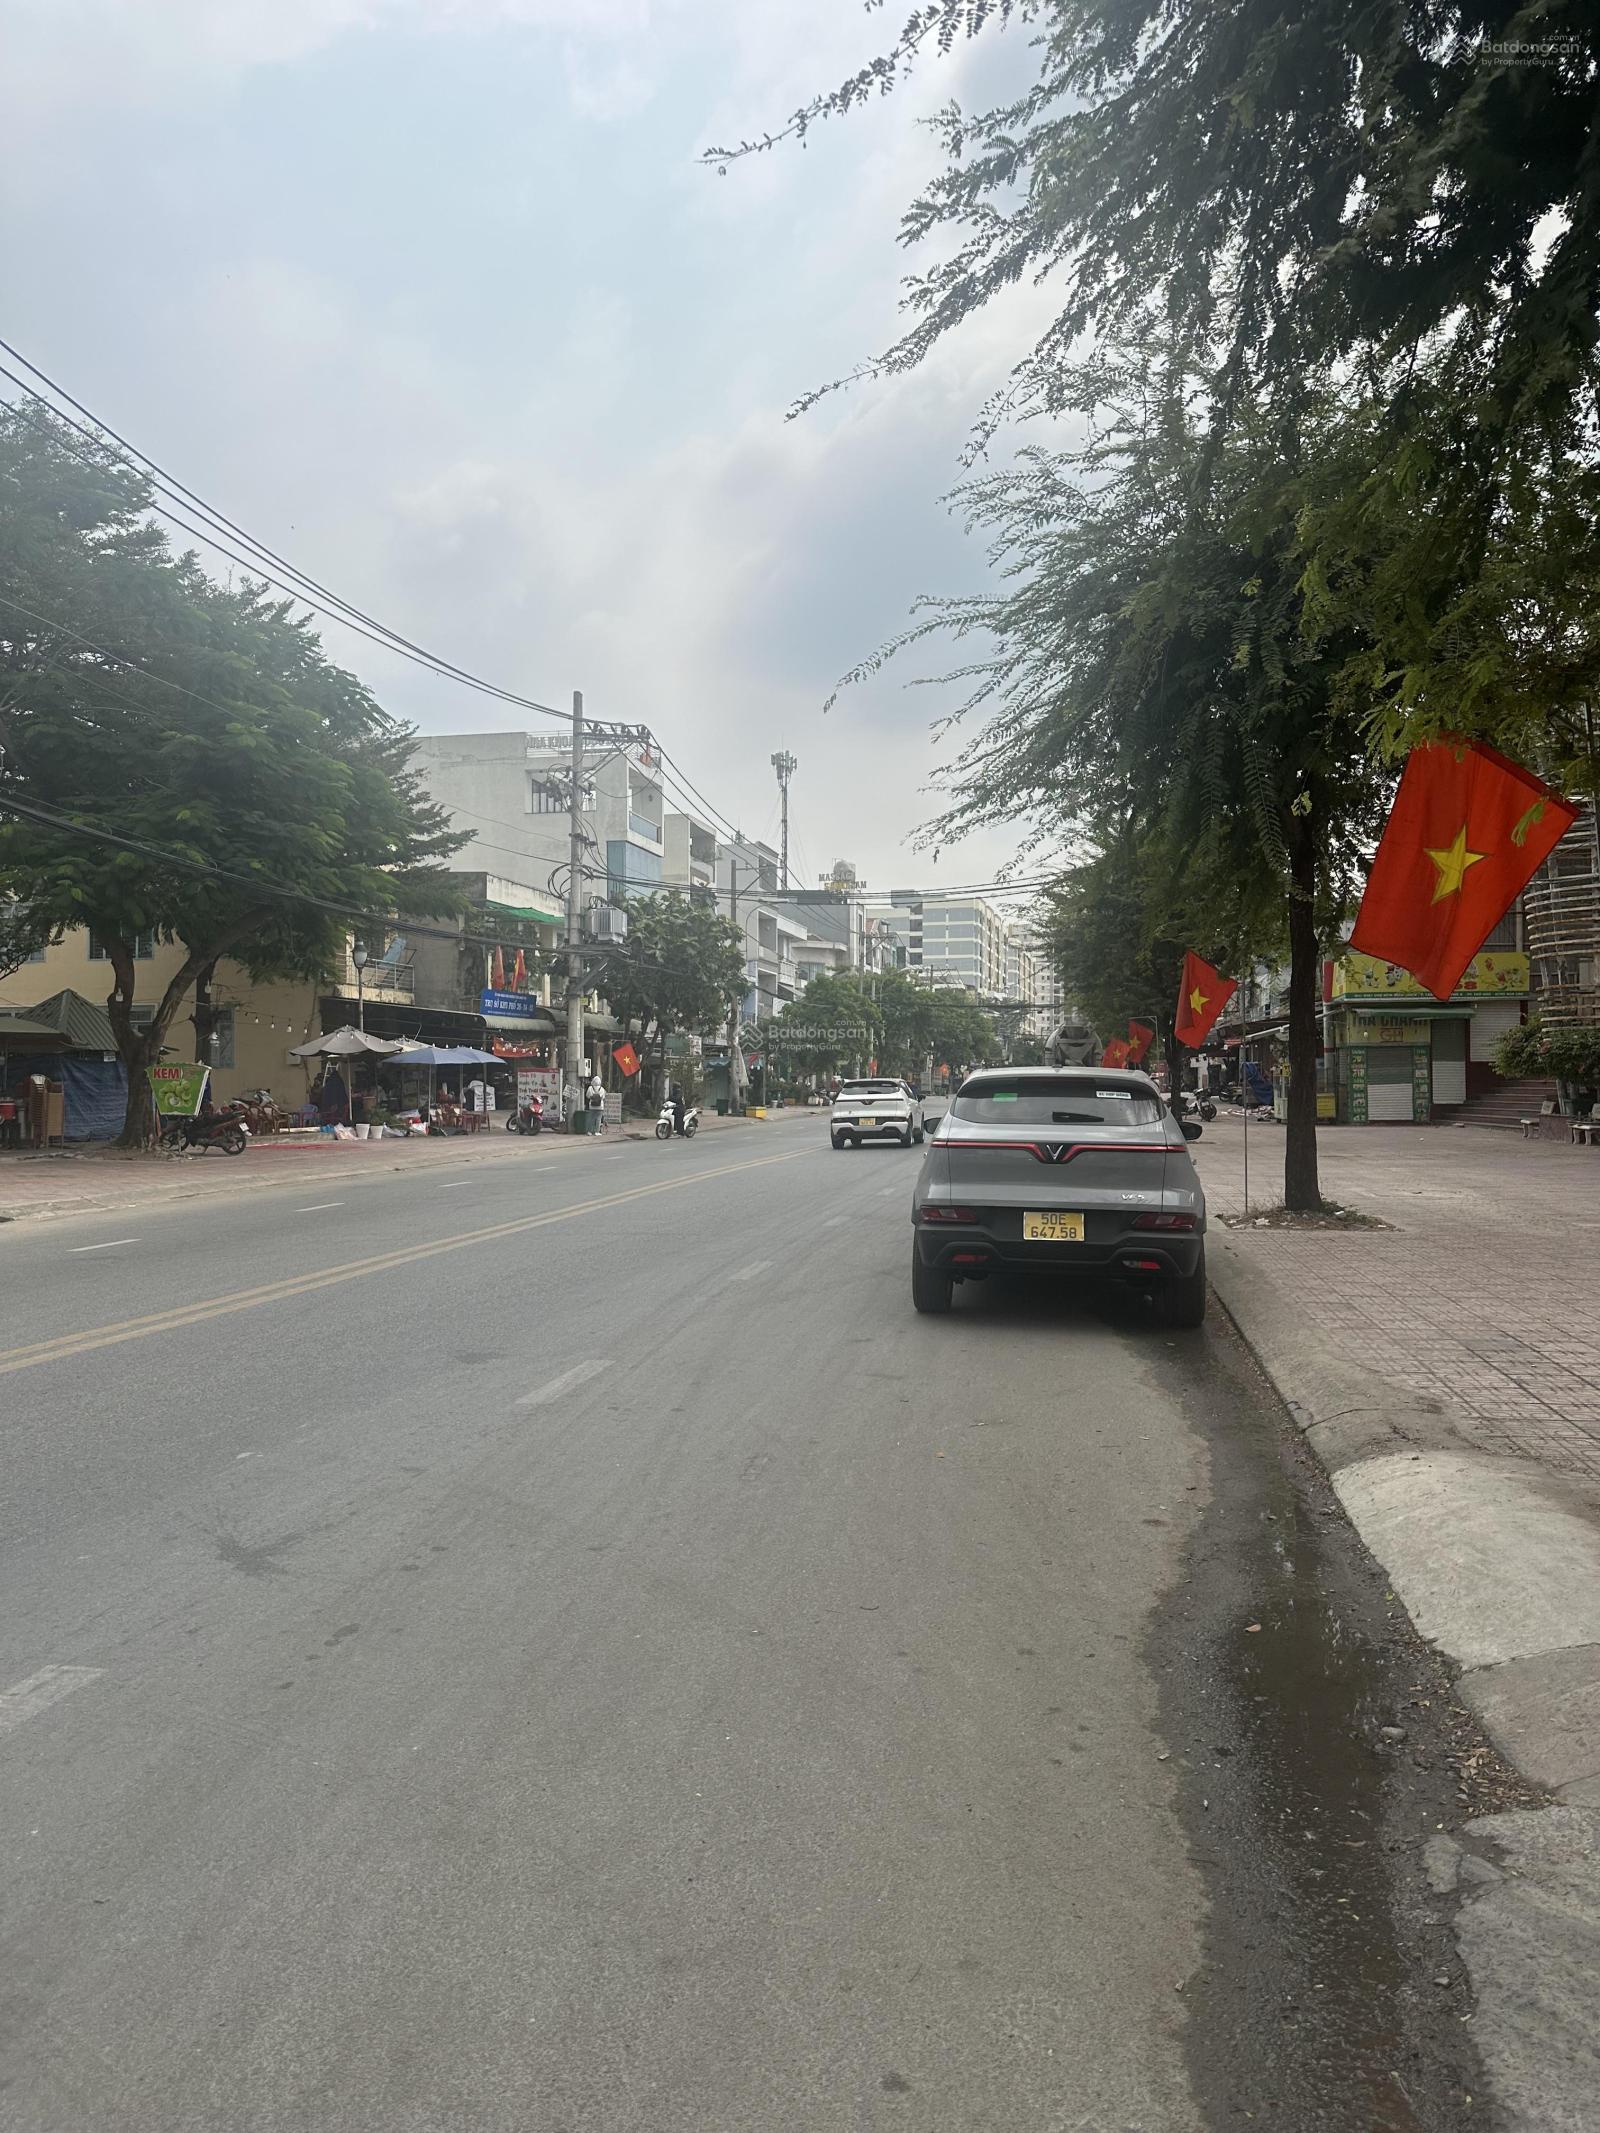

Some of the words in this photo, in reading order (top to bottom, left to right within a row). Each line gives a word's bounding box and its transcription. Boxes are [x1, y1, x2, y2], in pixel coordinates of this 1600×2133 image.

[153, 1068, 180, 1079] KEM
[1041, 1213, 1066, 1226] 50E
[1030, 1226, 1077, 1239] 647.58
